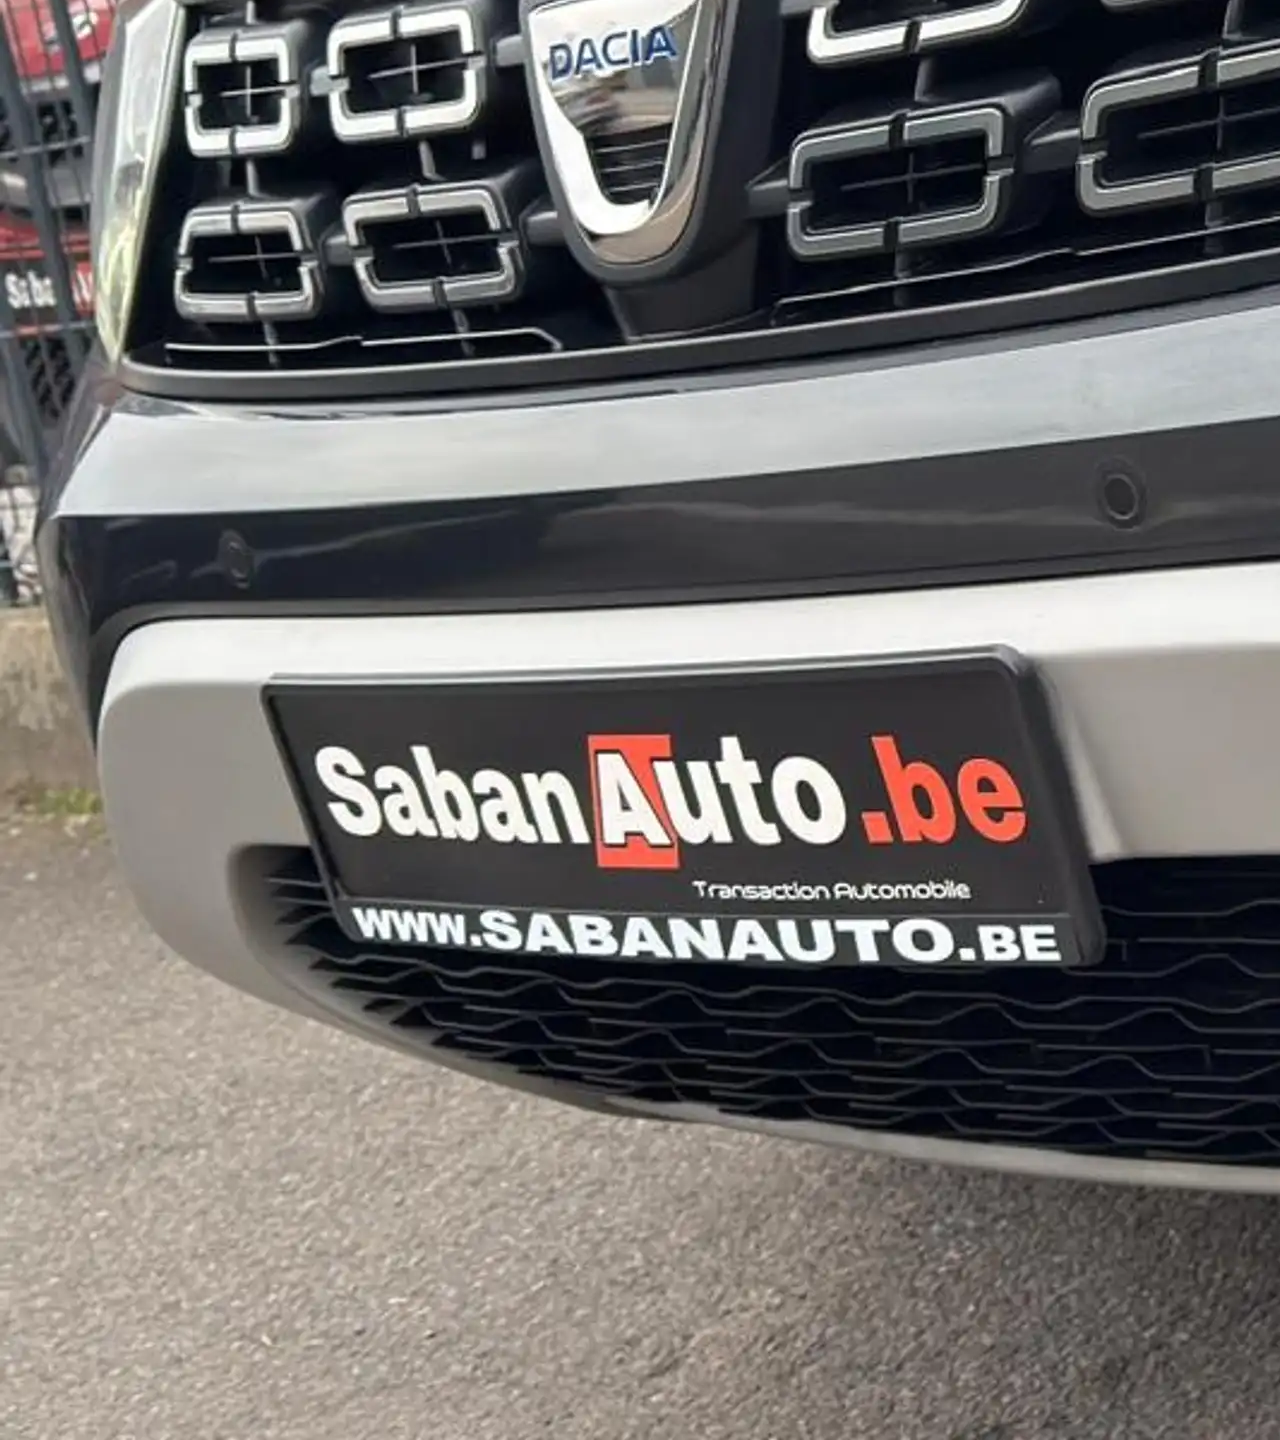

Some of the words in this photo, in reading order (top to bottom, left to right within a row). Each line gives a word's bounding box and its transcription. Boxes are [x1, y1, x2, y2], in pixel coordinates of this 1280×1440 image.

[549, 25, 678, 81] DACIA
[692, 879, 829, 901] Transaction
[834, 878, 972, 901] Automobile
[351, 906, 1062, 963] WWW.SABANAUTO.BE
